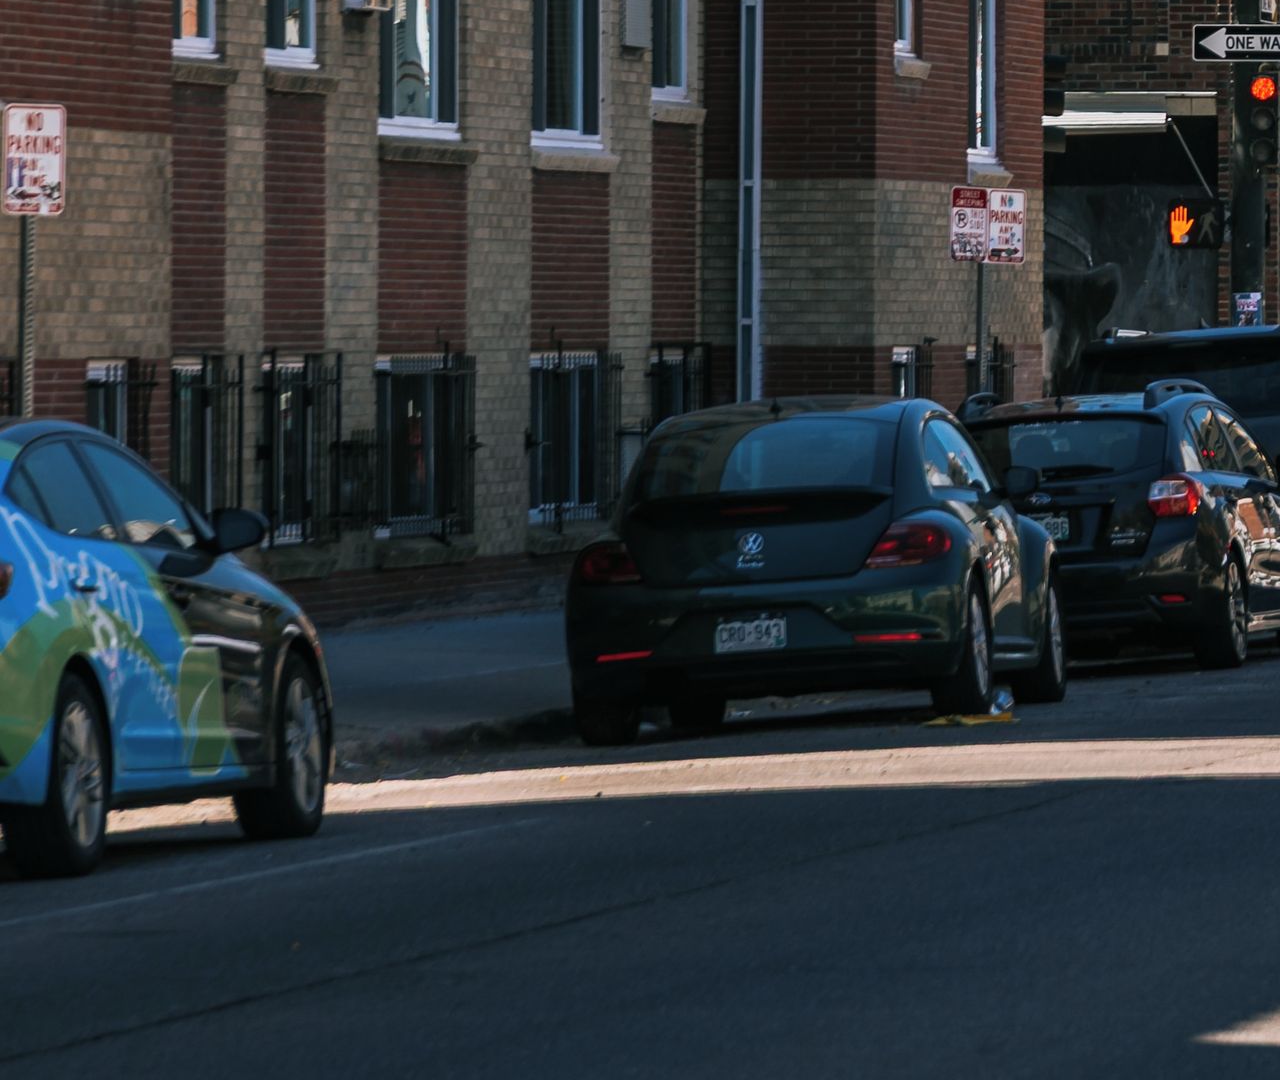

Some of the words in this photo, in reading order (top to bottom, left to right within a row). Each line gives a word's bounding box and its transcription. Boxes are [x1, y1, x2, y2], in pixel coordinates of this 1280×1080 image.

[1226, 36, 1254, 49] ONE
[8, 134, 61, 155] PARKING
[955, 199, 984, 207] SWEEPING
[991, 210, 1023, 224] PARKING
